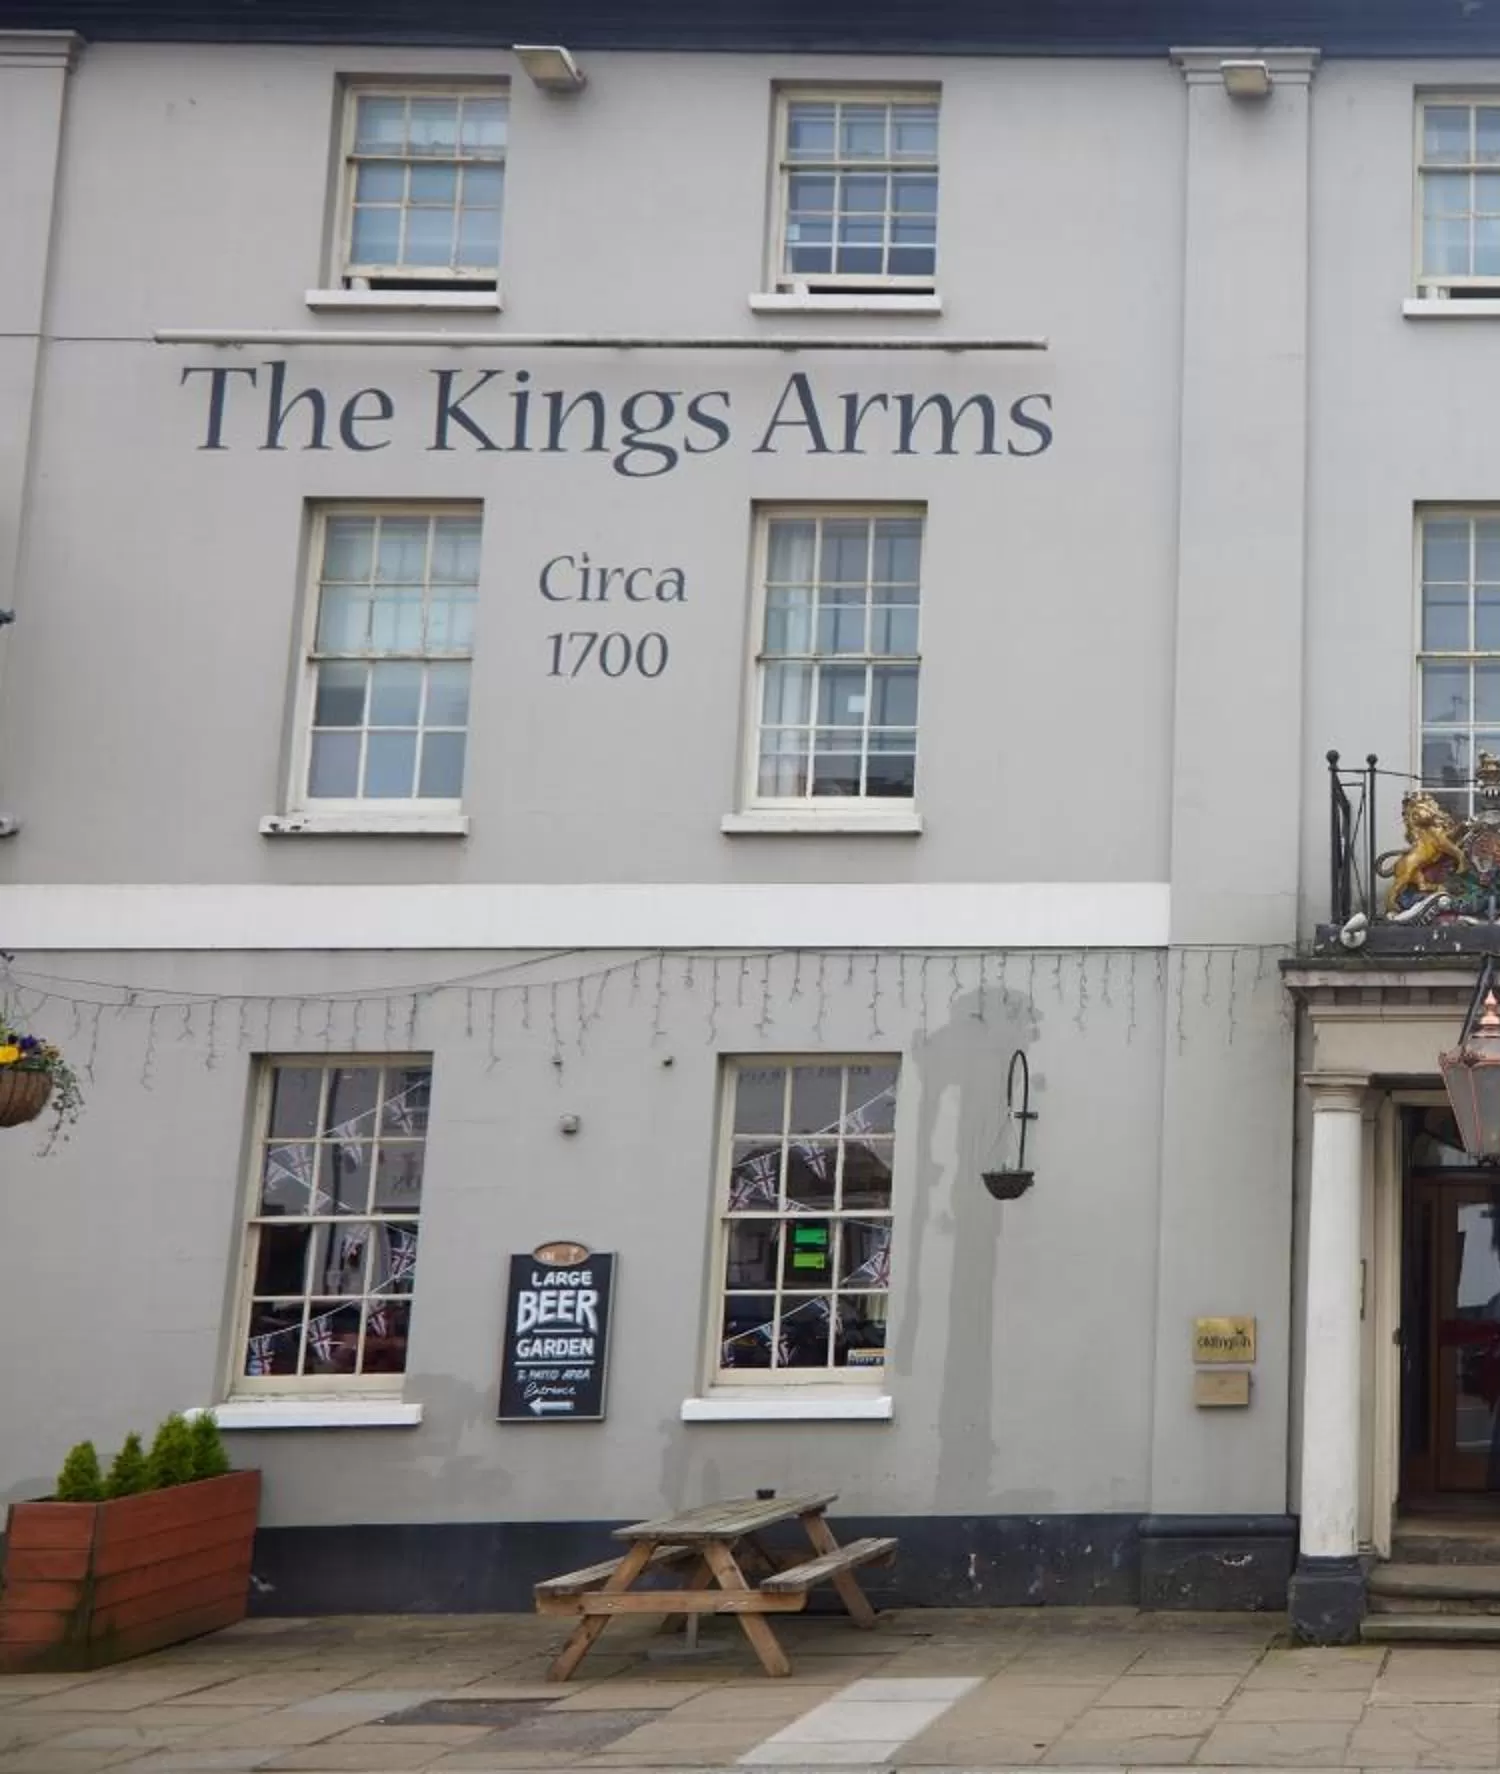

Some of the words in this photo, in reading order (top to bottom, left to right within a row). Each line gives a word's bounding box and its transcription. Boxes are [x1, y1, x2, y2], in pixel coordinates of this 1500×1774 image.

[179, 359, 396, 454] The
[426, 368, 732, 478] Kings
[751, 371, 1056, 458] Arms
[538, 554, 688, 604] Circa
[544, 631, 669, 679] 1700
[531, 1271, 593, 1287] LARGE
[516, 1290, 599, 1336] BEER
[515, 1338, 595, 1359] GARDEN
